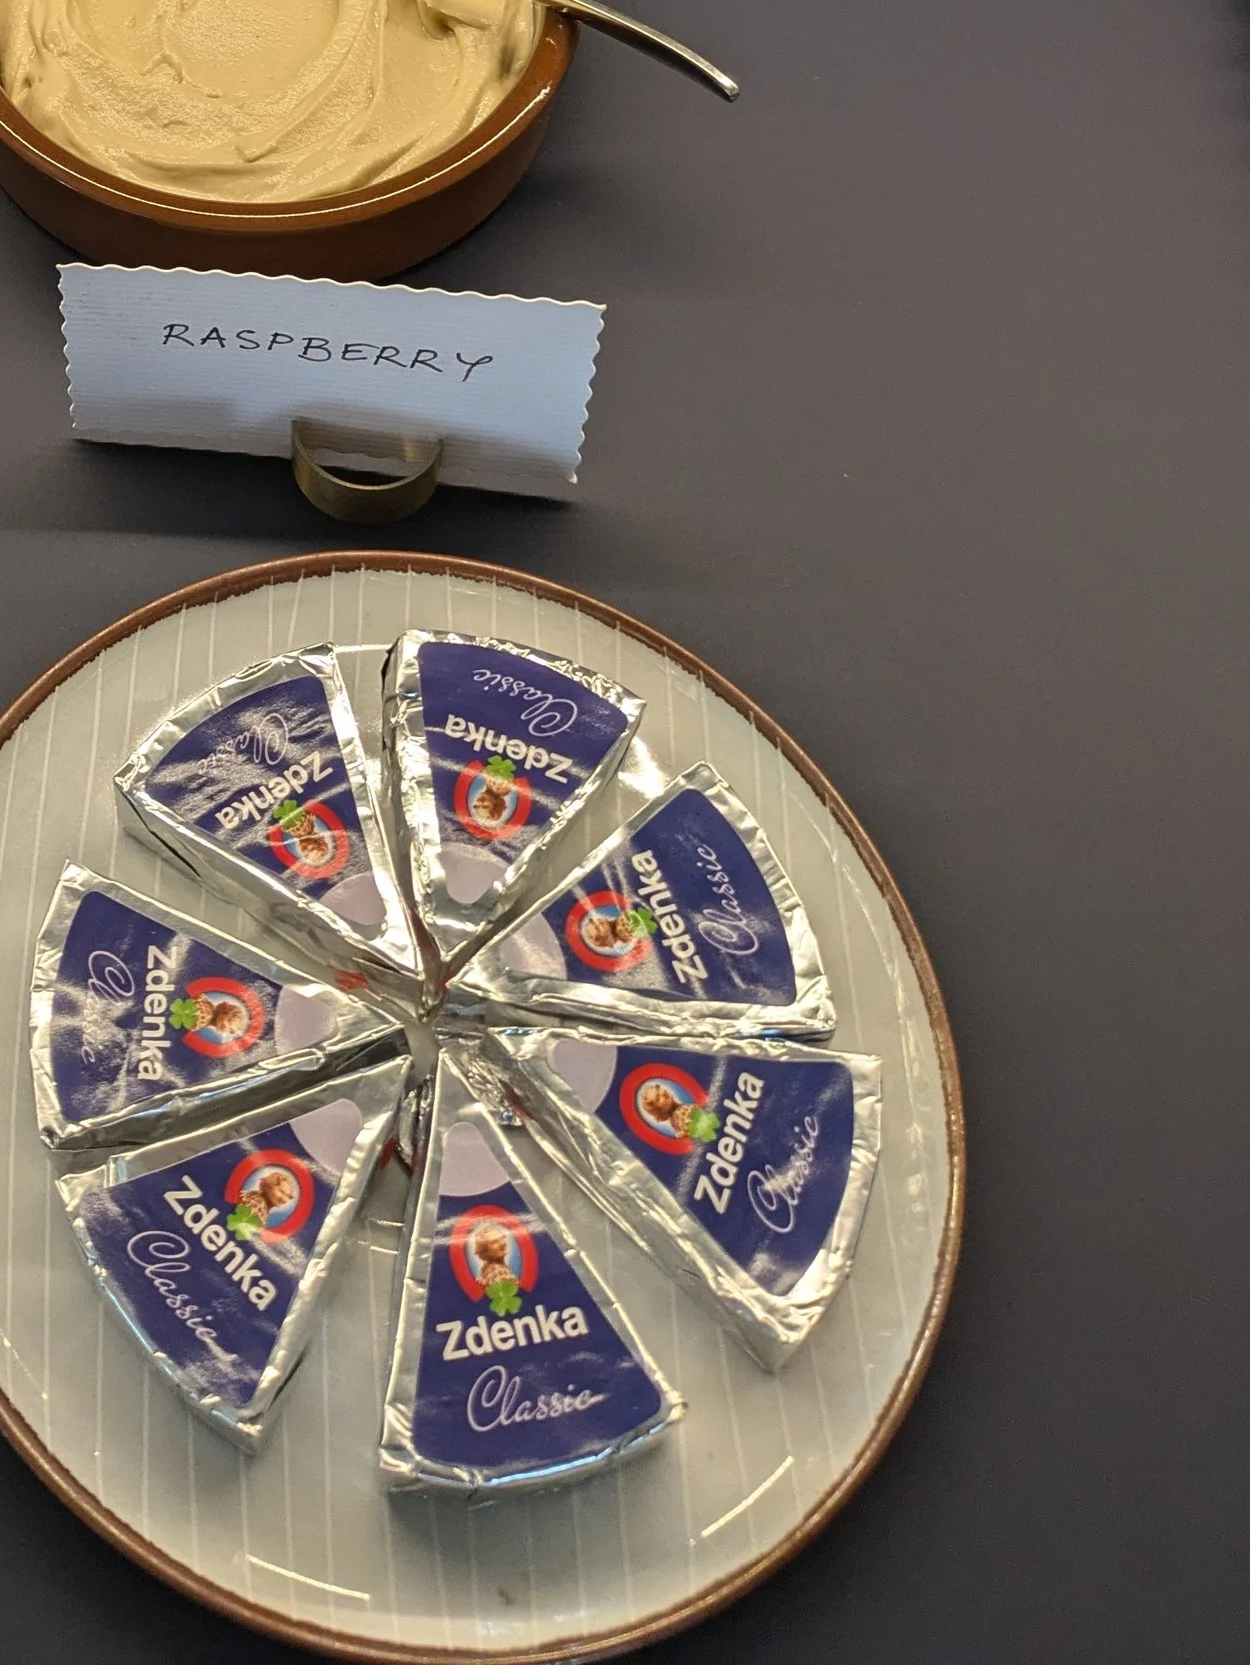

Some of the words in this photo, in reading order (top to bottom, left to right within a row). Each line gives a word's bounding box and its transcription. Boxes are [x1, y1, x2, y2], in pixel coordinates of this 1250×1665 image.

[162, 322, 494, 383] RASPBERRY
[196, 712, 290, 775] Classic
[444, 713, 574, 785] Zdenka
[473, 668, 579, 737] Classic
[215, 751, 334, 831] Zdenka
[631, 849, 710, 985] Zdenka
[696, 844, 760, 956] Classic
[138, 944, 178, 1081] Zdenka
[693, 1071, 766, 1216] Zdenka
[746, 1114, 819, 1235] Classic
[126, 1229, 220, 1343] Classic
[163, 1174, 278, 1313] Zdenka
[436, 1304, 590, 1362] Zdenka
[466, 1364, 602, 1432] Classic
